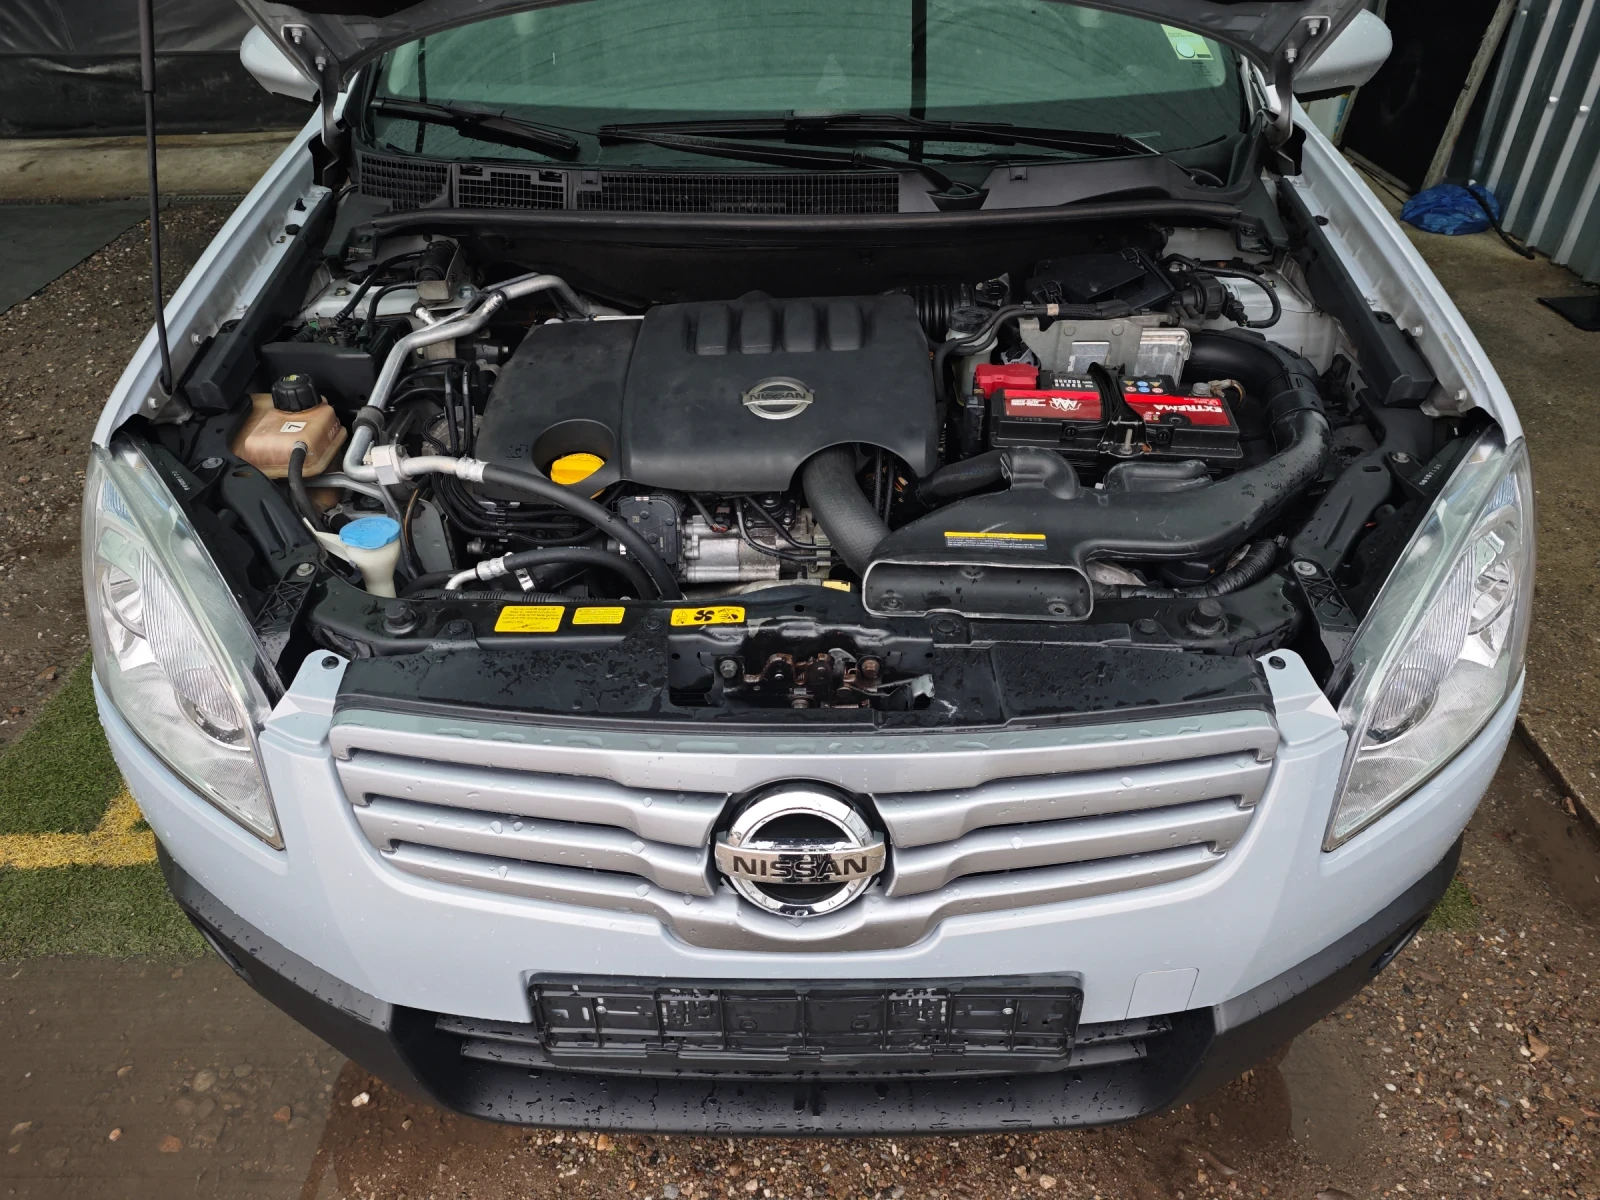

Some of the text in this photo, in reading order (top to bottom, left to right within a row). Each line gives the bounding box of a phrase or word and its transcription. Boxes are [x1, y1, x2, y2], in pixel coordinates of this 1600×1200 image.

[749, 392, 806, 401] NISSAN
[1153, 404, 1223, 413] EXTREMA
[733, 856, 868, 879] NISSAN
